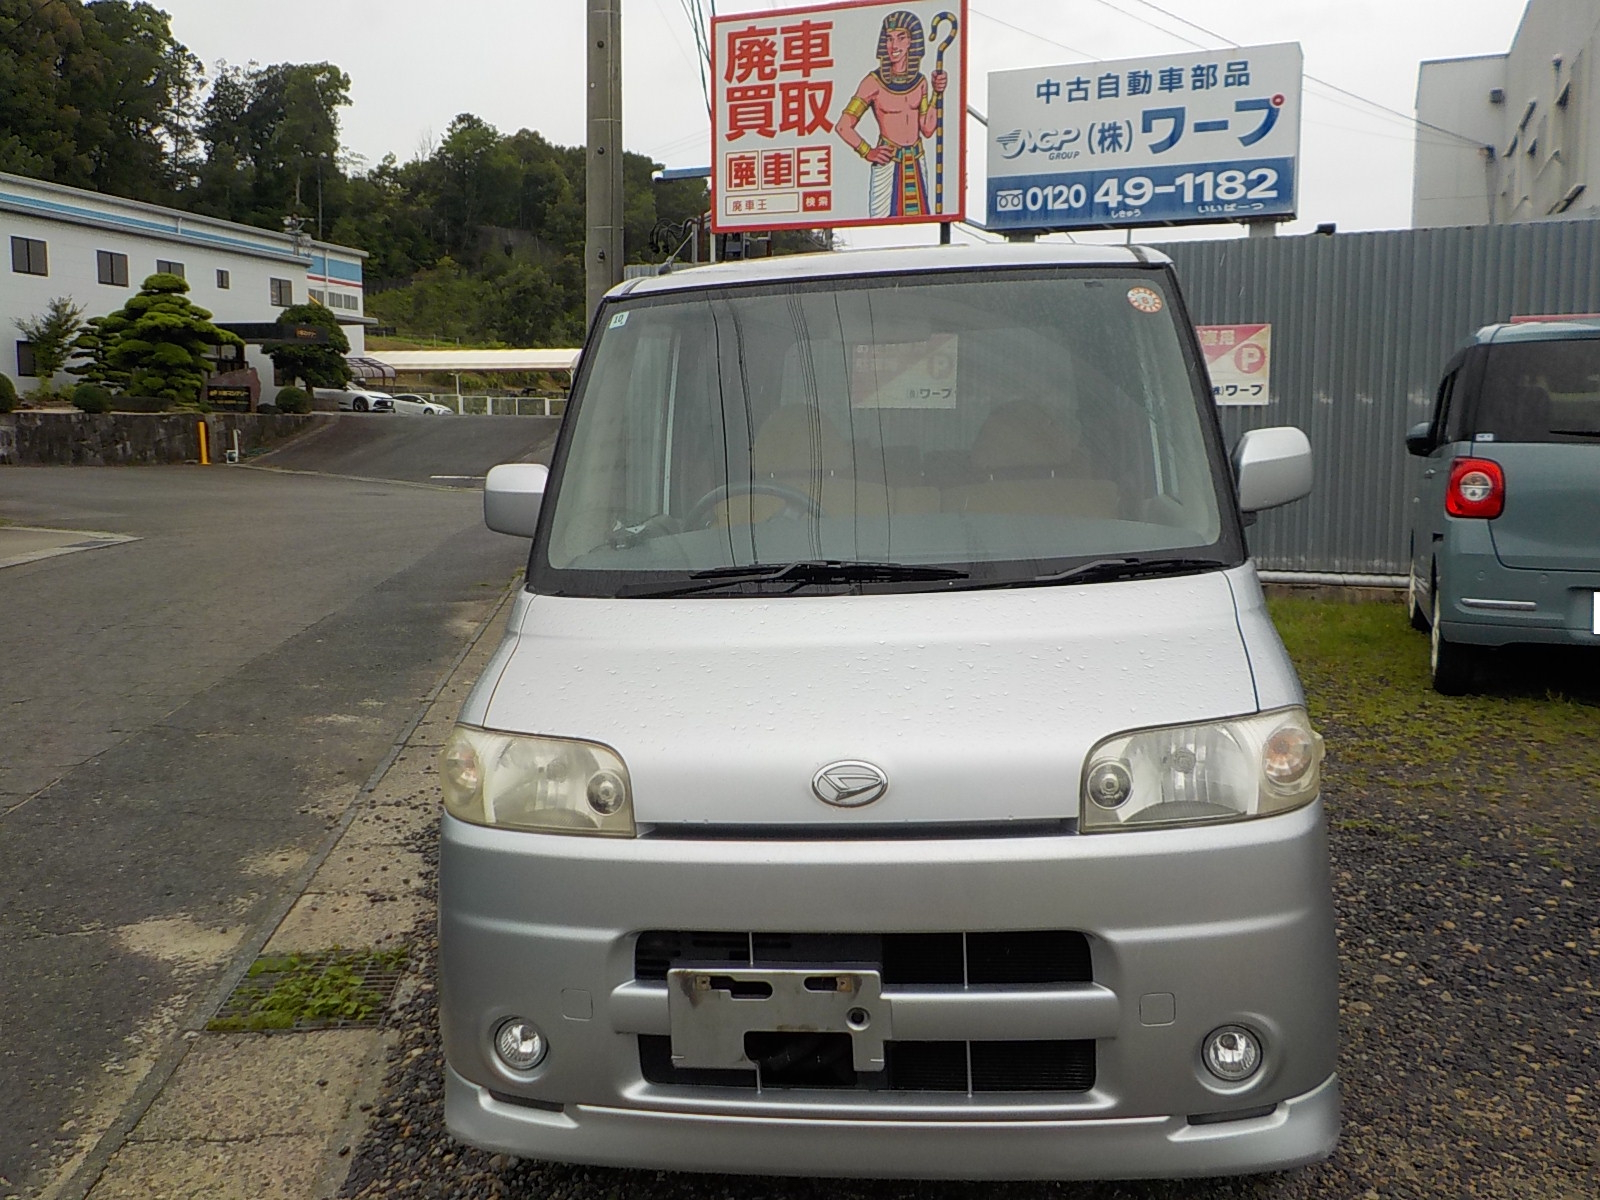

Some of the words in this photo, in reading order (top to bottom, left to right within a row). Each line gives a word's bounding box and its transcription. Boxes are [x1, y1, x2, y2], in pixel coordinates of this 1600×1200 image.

[724, 20, 834, 84] 廃車
[1036, 60, 1250, 104] 中古自動車部品
[725, 80, 834, 141] 買取
[727, 145, 831, 189] 廃車王
[1048, 150, 1080, 161] GROUP
[1026, 183, 1087, 211] 0120
[1094, 168, 1279, 208] 49-1182
[1242, 347, 1261, 371] P
